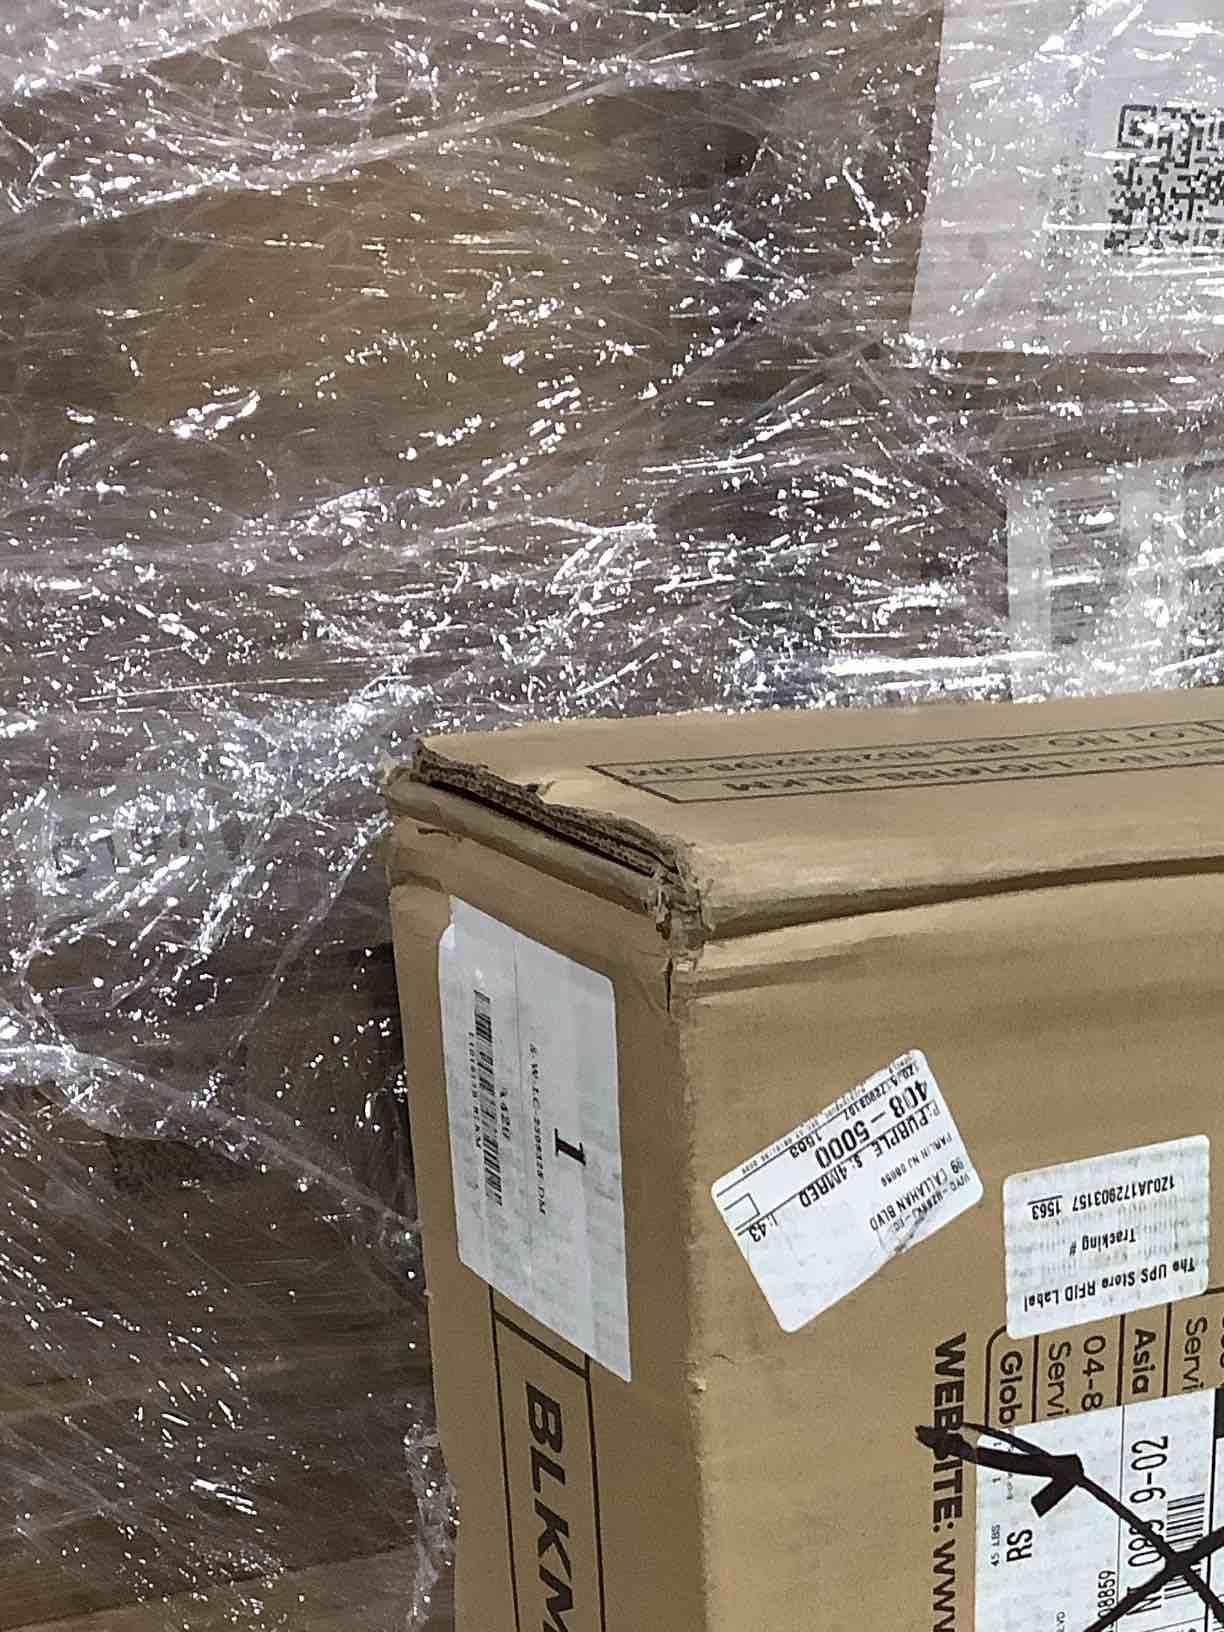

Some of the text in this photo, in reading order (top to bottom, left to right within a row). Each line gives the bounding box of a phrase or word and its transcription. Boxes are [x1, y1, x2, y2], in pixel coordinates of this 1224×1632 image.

[815, 1120, 872, 1170] 5000
[895, 1166, 950, 1215] CALLAHAN
[1031, 1200, 1063, 1220] 1563
[869, 1199, 897, 1232] BLVD
[1069, 1227, 1137, 1257] Tracking #
[1023, 1257, 1196, 1313] The UPS Store RFID Label
[1131, 1327, 1157, 1395] Asia
[931, 1331, 967, 1534] WEBITE:
[1129, 1434, 1168, 1504] 9-02
[991, 1524, 1002, 1547] LBS
[1006, 1528, 1033, 1563] RS
